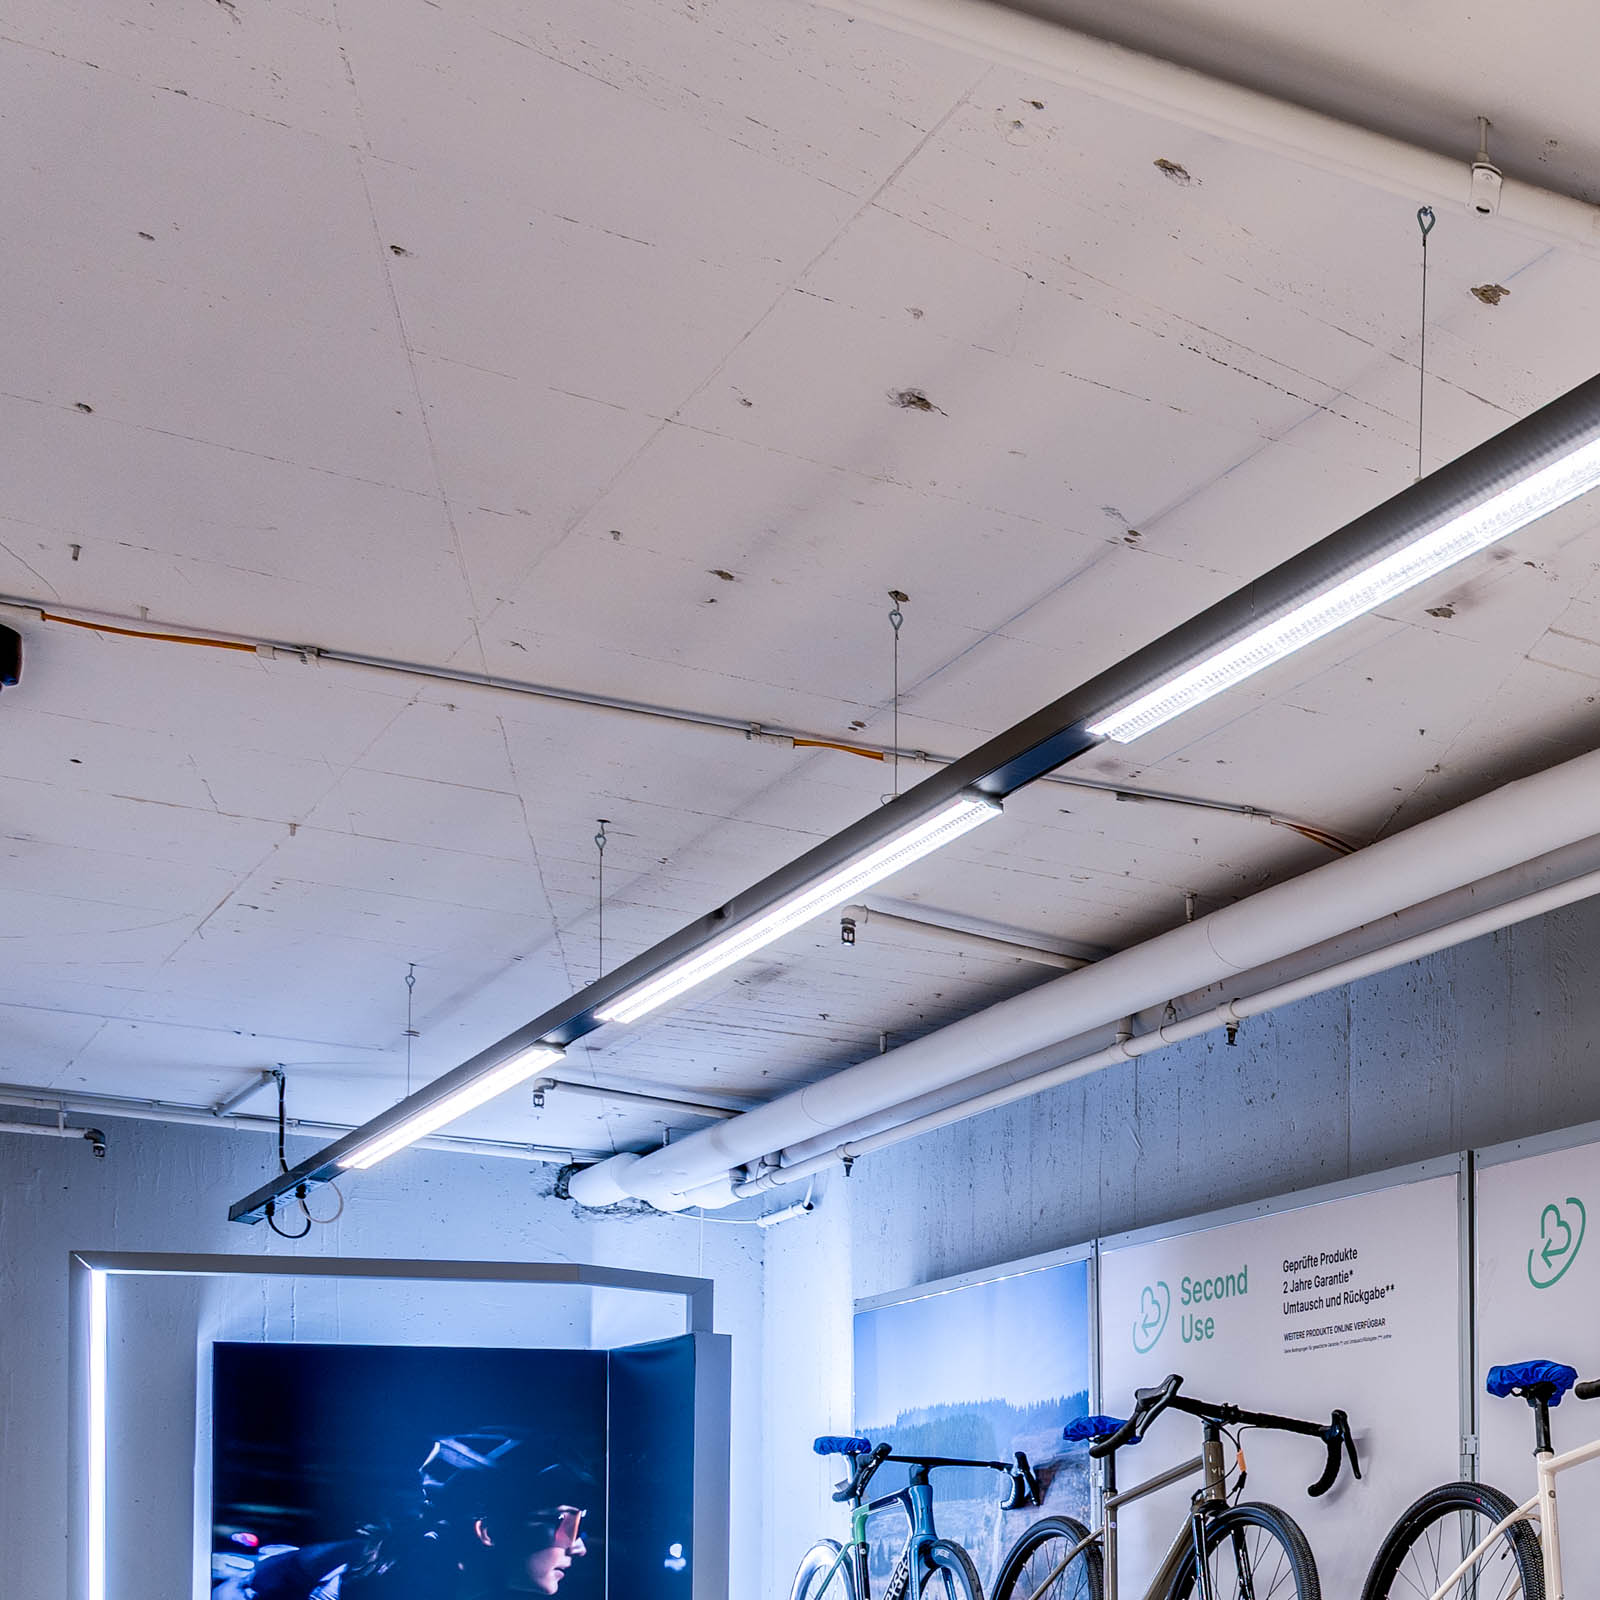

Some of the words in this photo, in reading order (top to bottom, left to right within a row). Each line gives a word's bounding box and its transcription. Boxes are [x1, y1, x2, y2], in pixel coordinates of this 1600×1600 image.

[1282, 1256, 1319, 1276] Geprüfte
[1320, 1247, 1358, 1267] Produkte
[1181, 1264, 1248, 1305] Second
[1283, 1281, 1289, 1294] 2
[1290, 1275, 1312, 1293] Jahre
[1283, 1296, 1324, 1315] Umtausch
[1325, 1291, 1341, 1307] und
[1181, 1313, 1215, 1343] Use
[1284, 1330, 1305, 1341] WEITERE
[1305, 1326, 1333, 1338] PRODUKTE
[1333, 1323, 1353, 1333] ONLINE
[1353, 1318, 1386, 1330] VERFÜGBAR
